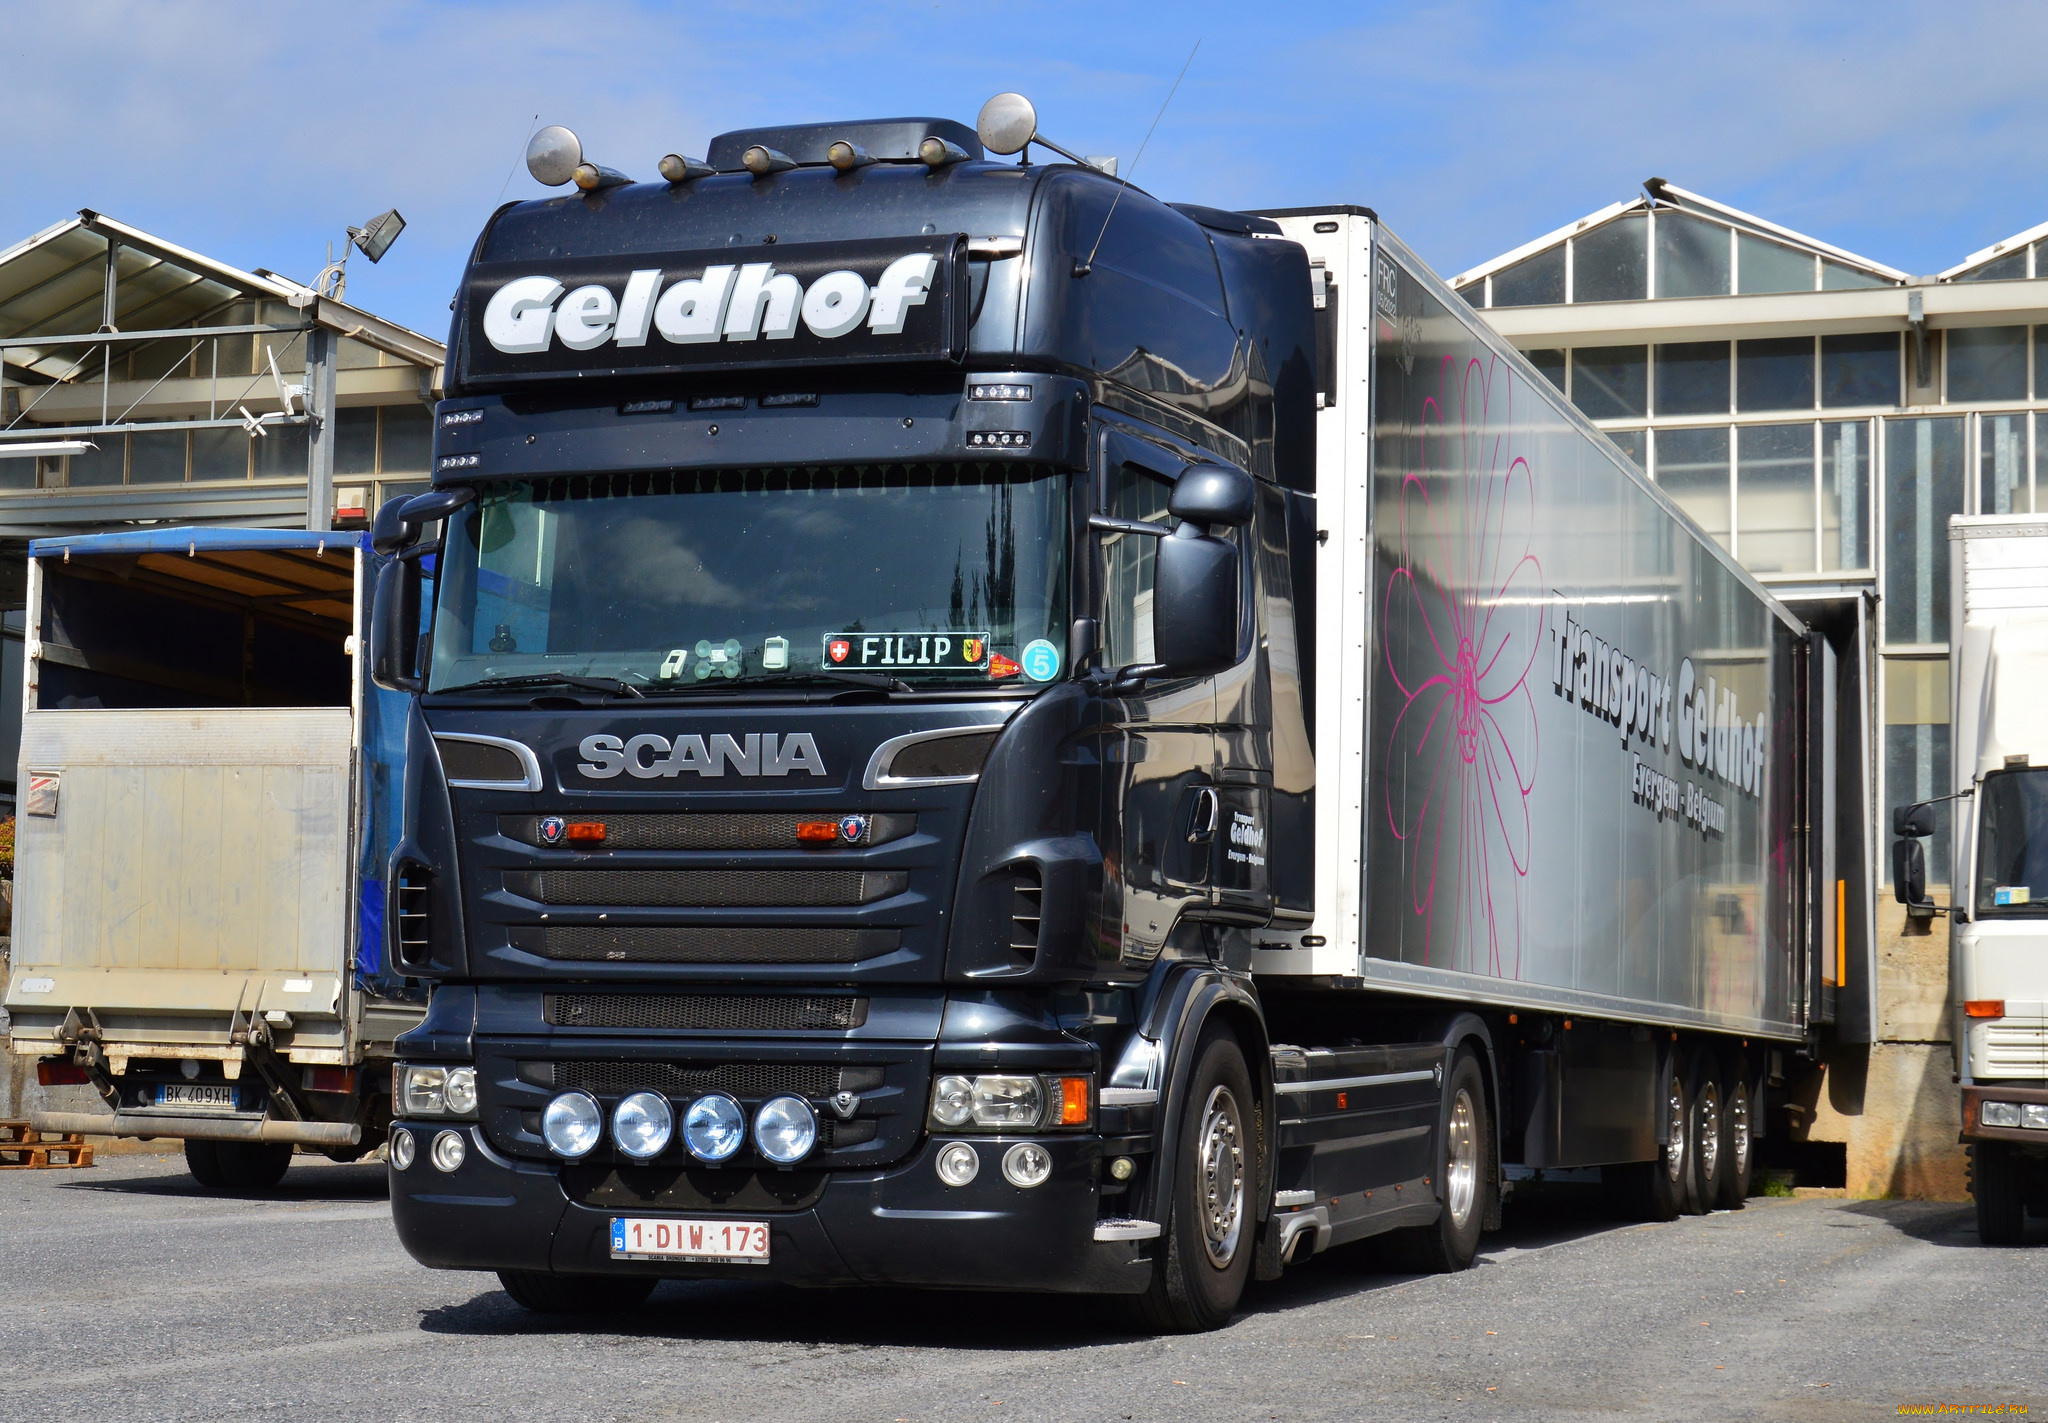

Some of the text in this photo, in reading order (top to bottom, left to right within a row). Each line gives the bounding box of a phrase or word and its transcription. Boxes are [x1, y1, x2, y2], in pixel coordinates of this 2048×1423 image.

[1377, 257, 1396, 298] FRC
[483, 253, 937, 354] Geldhof
[861, 637, 951, 664] FILIP
[1032, 654, 1050, 676] 5
[1551, 589, 1765, 799] Transport Geldhof
[577, 732, 827, 779] SCANIA
[1632, 752, 1679, 822] Evergem
[1686, 779, 1725, 841] Belgium
[1230, 822, 1264, 848] Geldhof
[614, 1237, 624, 1249] B
